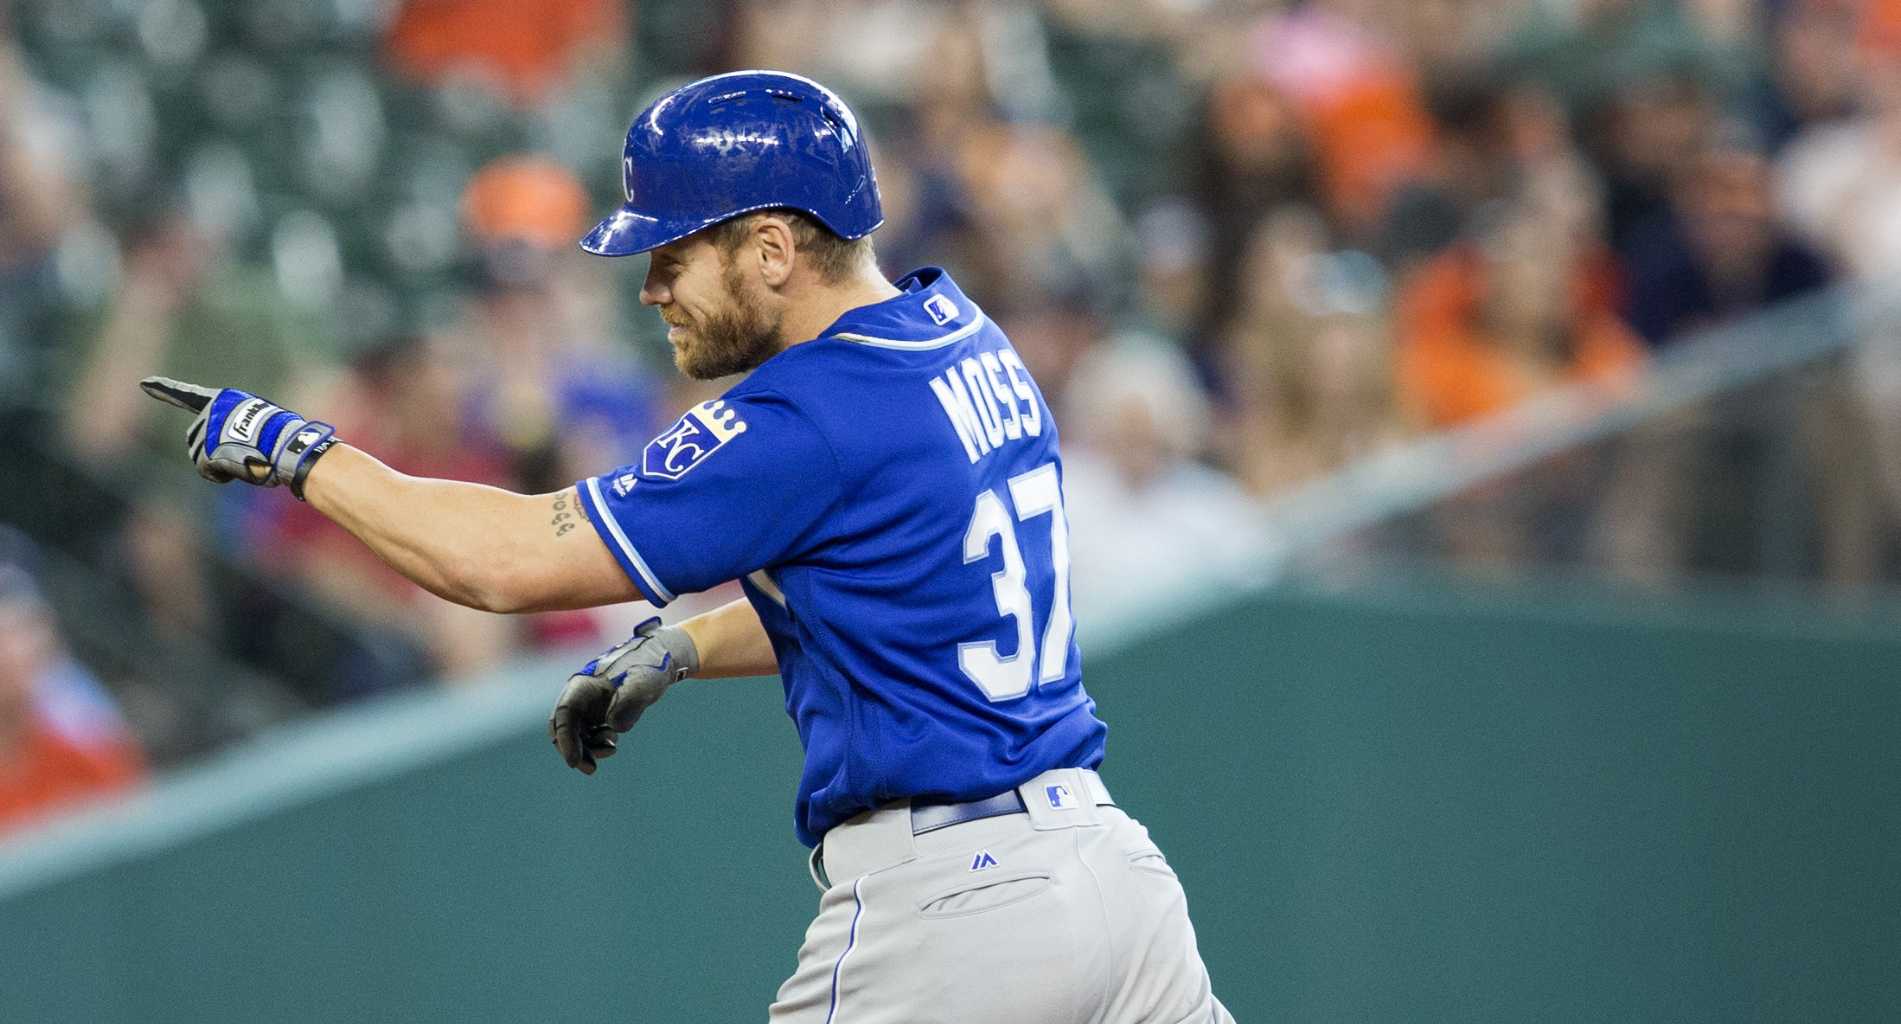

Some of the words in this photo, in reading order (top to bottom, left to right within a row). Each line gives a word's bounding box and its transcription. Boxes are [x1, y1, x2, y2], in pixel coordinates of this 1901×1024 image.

[656, 418, 705, 472] KC
[928, 348, 1042, 465] MOSS
[957, 461, 1073, 703] 37
